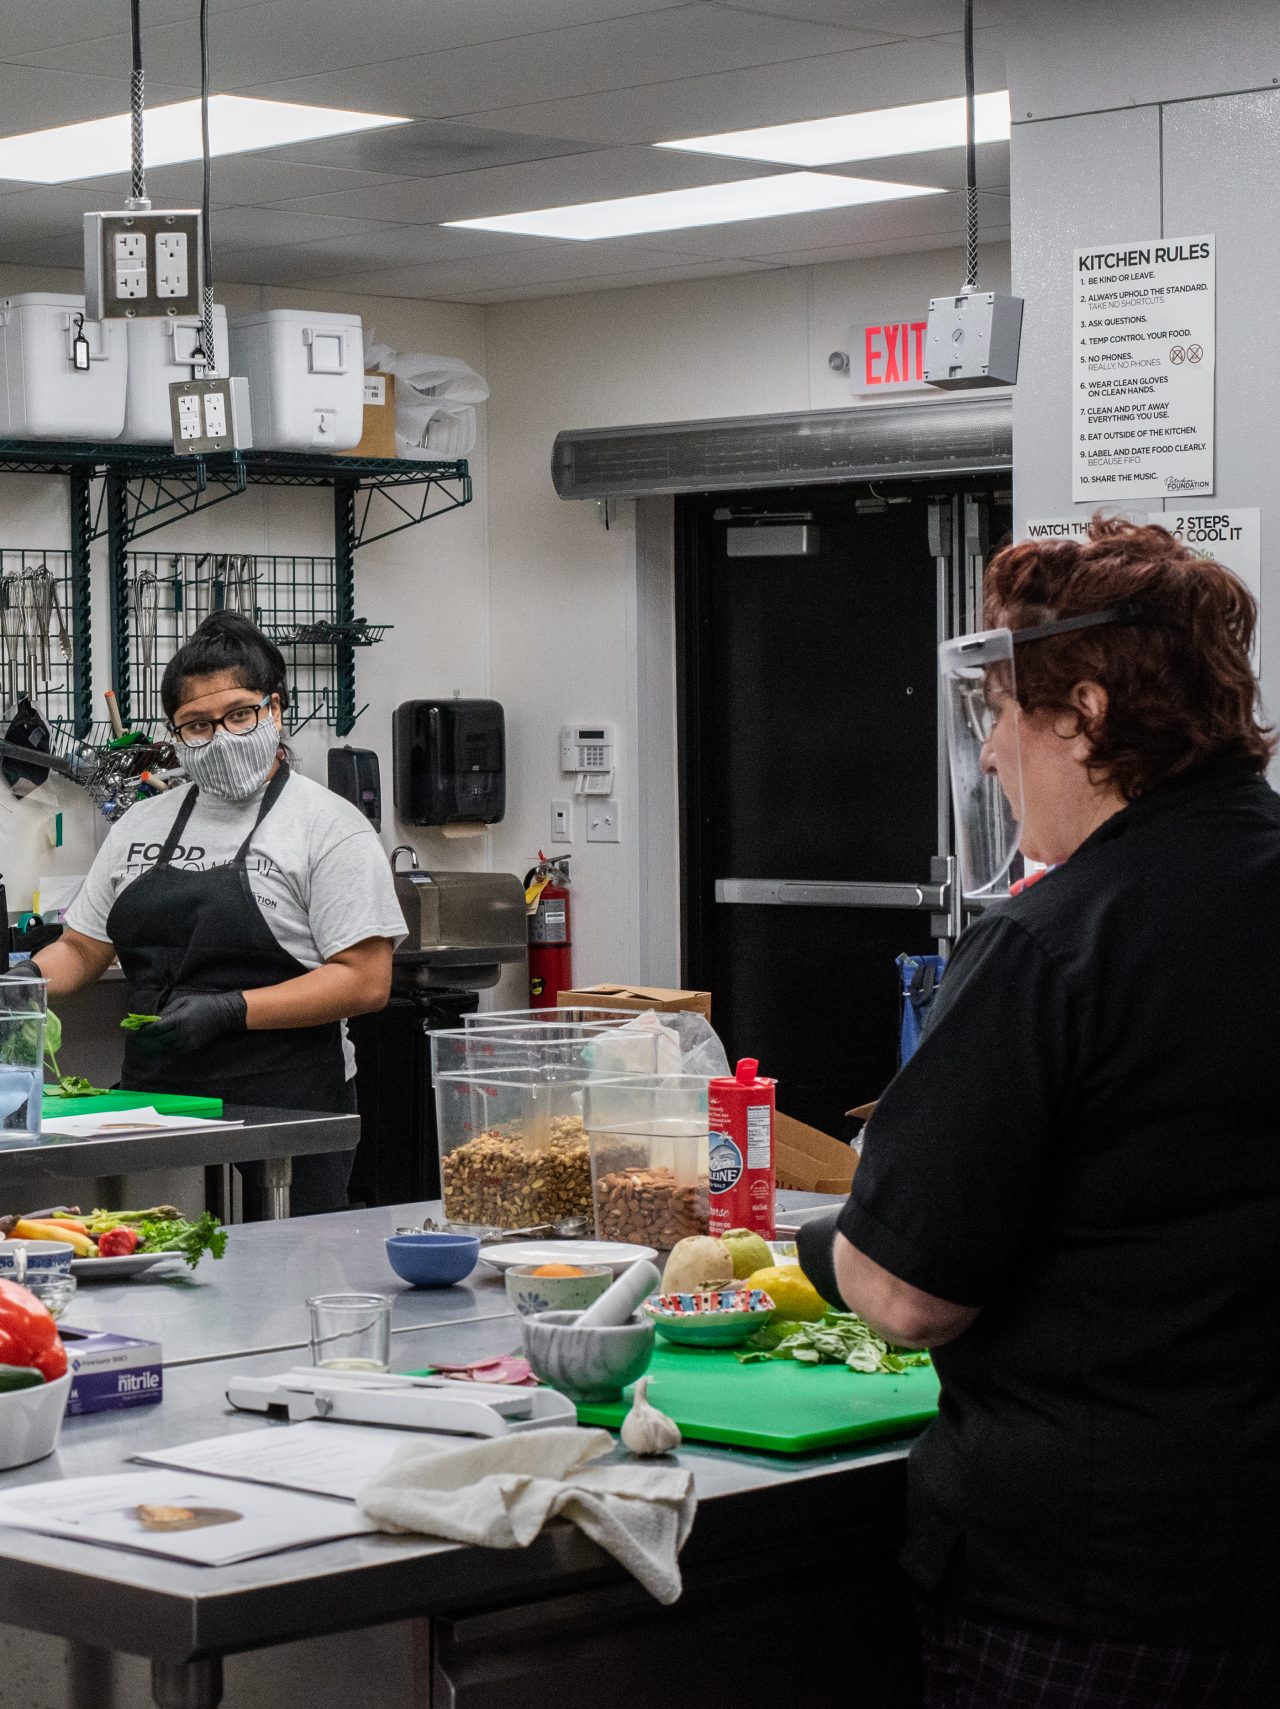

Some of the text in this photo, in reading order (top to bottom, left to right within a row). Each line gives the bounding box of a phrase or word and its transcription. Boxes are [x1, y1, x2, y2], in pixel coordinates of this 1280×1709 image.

[1079, 243, 1210, 271] KITCHEN RULES
[1088, 277, 1098, 285] BE
[1100, 276, 1117, 284] KIND
[1130, 271, 1155, 280] LEAVE.
[1088, 292, 1118, 302] ALWAYS
[1119, 289, 1149, 299] UPHOLD
[1166, 283, 1208, 294] STANDARD.
[1088, 302, 1107, 310] TAKE
[1104, 316, 1147, 326] QUESTIONS.
[1110, 334, 1145, 343] CONTROL
[1147, 331, 1167, 339] YOUR
[1168, 329, 1191, 338] FOOD.
[865, 322, 927, 385] EXIT
[1089, 355, 1099, 363] NO
[1101, 353, 1133, 361] PHONES.
[1117, 361, 1129, 369] NO
[1089, 380, 1112, 388] WEAR
[1113, 378, 1138, 387] CLEAN
[1140, 376, 1168, 385] GLOVES
[1101, 388, 1126, 396] CLEAN
[1128, 386, 1155, 394] HANDS.
[1087, 407, 1112, 415] CLEAN
[1114, 405, 1130, 413] AND
[1132, 404, 1146, 412] PUT
[1148, 402, 1170, 410] AWAY
[1088, 414, 1135, 423] EVERYTHING
[1153, 411, 1170, 419] USE.
[1103, 431, 1135, 439] OUTSIDE
[1165, 427, 1197, 435] KITCHEN.
[1088, 449, 1112, 458] LABEL
[1113, 448, 1130, 456] AND
[1131, 447, 1150, 455] DATE
[1152, 445, 1174, 454] FOOD
[1175, 443, 1207, 452] CLEARLY.
[1088, 457, 1122, 466] BECAUSE
[1091, 475, 1116, 483] SHARE
[1133, 472, 1158, 480] MUSIC.
[1167, 481, 1209, 489] FOUNDATION
[1177, 516, 1229, 529] 2 STEPS
[1029, 524, 1070, 537] WATCH
[1187, 529, 1227, 542] COOL
[1230, 528, 1242, 540] IT
[127, 842, 205, 862] FOOD
[118, 1371, 159, 1392] nitrile
